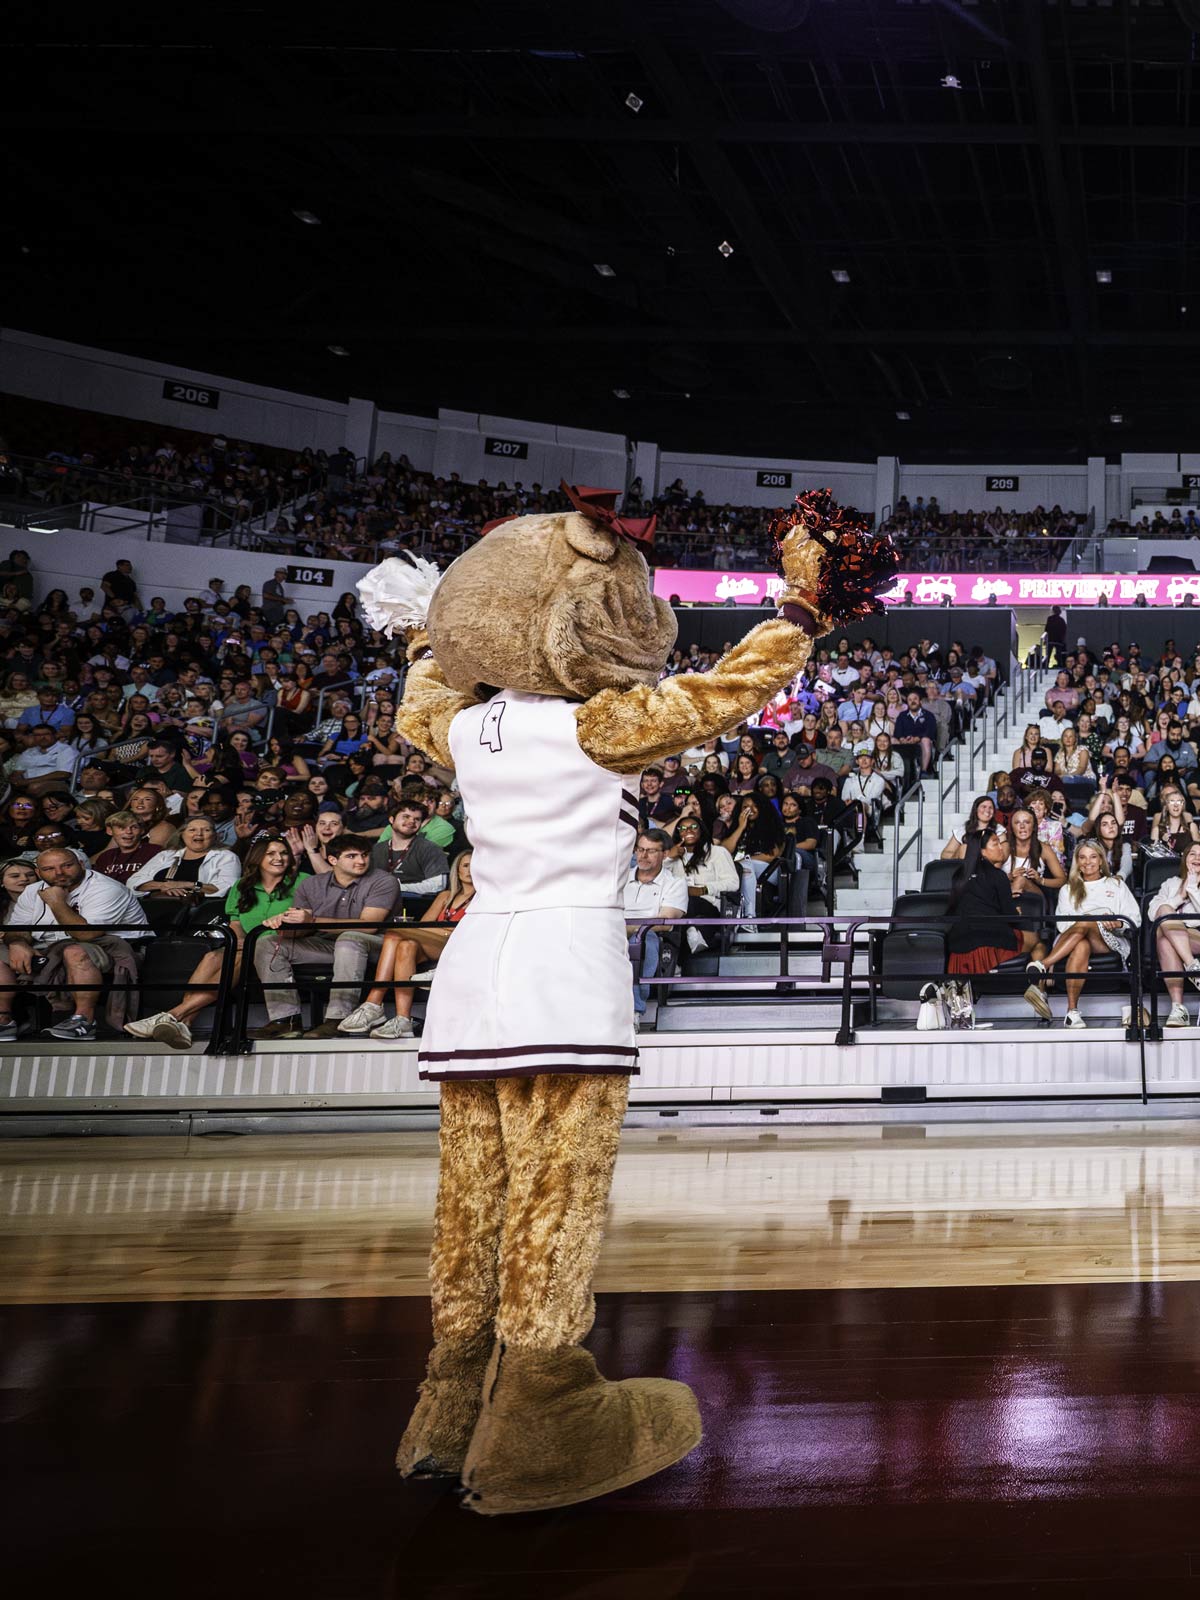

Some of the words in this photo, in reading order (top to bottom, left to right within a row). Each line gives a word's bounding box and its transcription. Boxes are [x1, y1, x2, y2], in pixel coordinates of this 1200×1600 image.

[172, 386, 209, 404] 206
[492, 441, 520, 456] 207
[762, 474, 786, 486] 208
[991, 479, 1014, 489] 209
[294, 568, 325, 584] 104
[1019, 578, 1117, 598] PREVIEW
[1120, 579, 1160, 598] DAY
[104, 862, 143, 874] STATE
